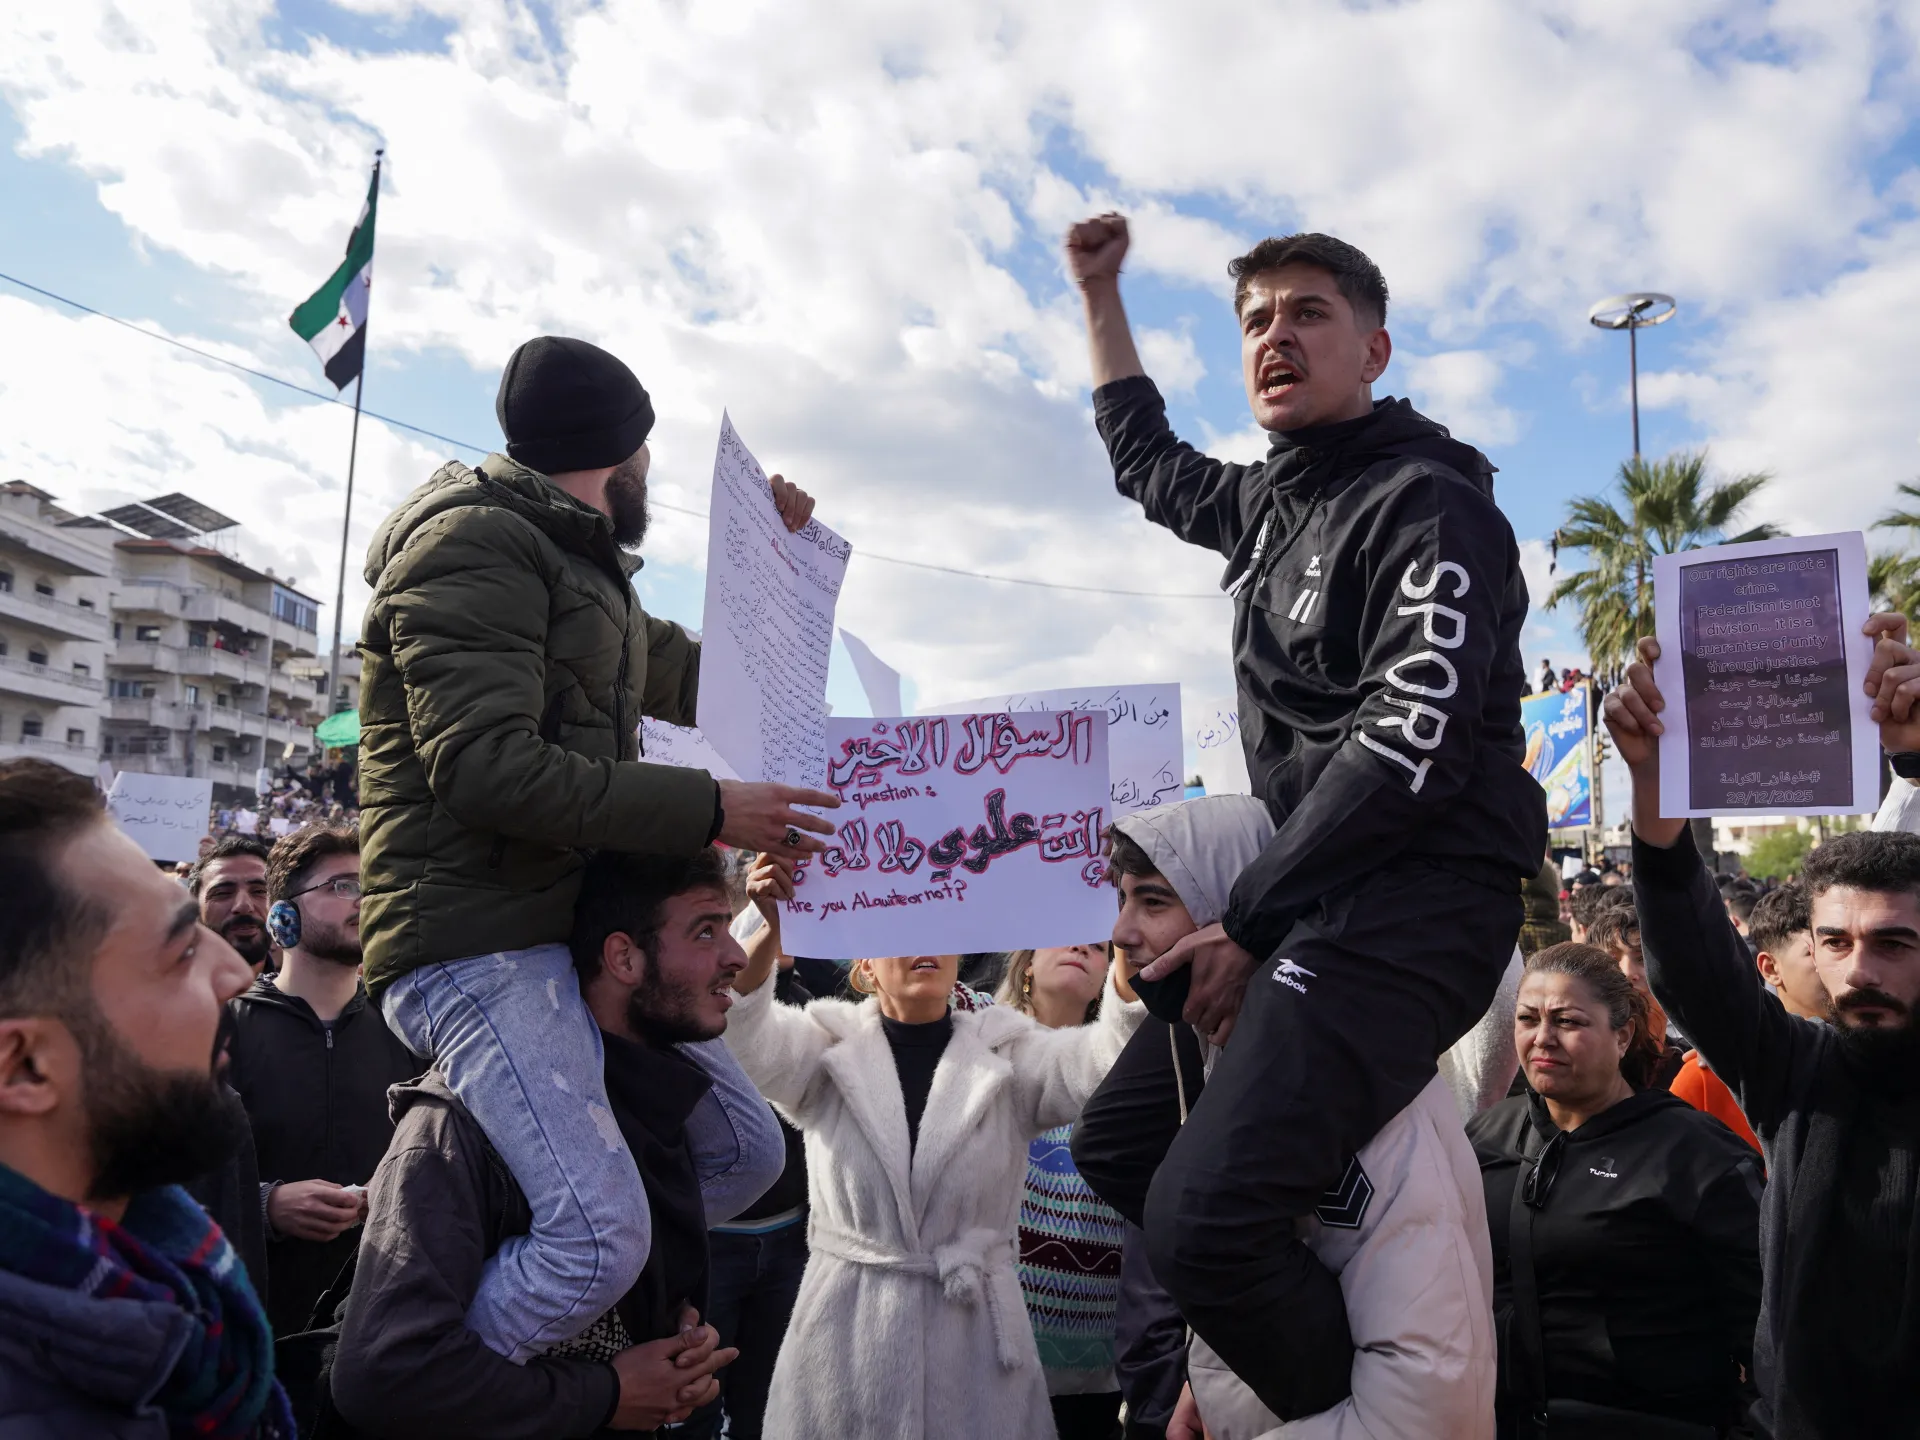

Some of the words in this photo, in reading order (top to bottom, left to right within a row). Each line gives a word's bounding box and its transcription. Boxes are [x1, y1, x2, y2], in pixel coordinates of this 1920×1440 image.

[1689, 570, 1713, 582] Our
[1716, 564, 1758, 580] rights
[1761, 562, 1785, 574] are
[1788, 558, 1814, 572] not
[1816, 558, 1826, 569] a
[1734, 582, 1780, 596] crime.
[1699, 601, 1776, 619] Federalism
[1779, 599, 1792, 610] is
[1795, 596, 1821, 609] not
[1707, 621, 1771, 636] division...
[1775, 618, 1786, 631] it
[1789, 617, 1801, 629] is
[1805, 617, 1814, 628] a
[1696, 640, 1768, 658] guarantee
[1772, 636, 1787, 650] of
[1791, 634, 1828, 649] unity
[1707, 657, 1764, 674] through
[1766, 655, 1820, 672] justice.
[1358, 560, 1471, 794] SPORT
[1747, 674, 1781, 689] ليست
[1784, 673, 1828, 687] حقوقنا
[1719, 695, 1752, 710] ليست
[1756, 692, 1813, 709] الفيدرالية
[1711, 716, 1744, 731] ضمان
[953, 711, 1092, 775] السؤال
[1700, 735, 1738, 748] العدالة
[1741, 734, 1772, 750] خلال
[1775, 736, 1794, 748] من
[1797, 730, 1840, 745] للوحدة
[852, 783, 920, 810] question
[1726, 789, 1814, 805] 28/12/2025
[927, 787, 1041, 883] علوي
[873, 819, 927, 875] ولا
[786, 899, 814, 914] Are
[819, 900, 847, 921] you
[1272, 970, 1307, 994] Reebok
